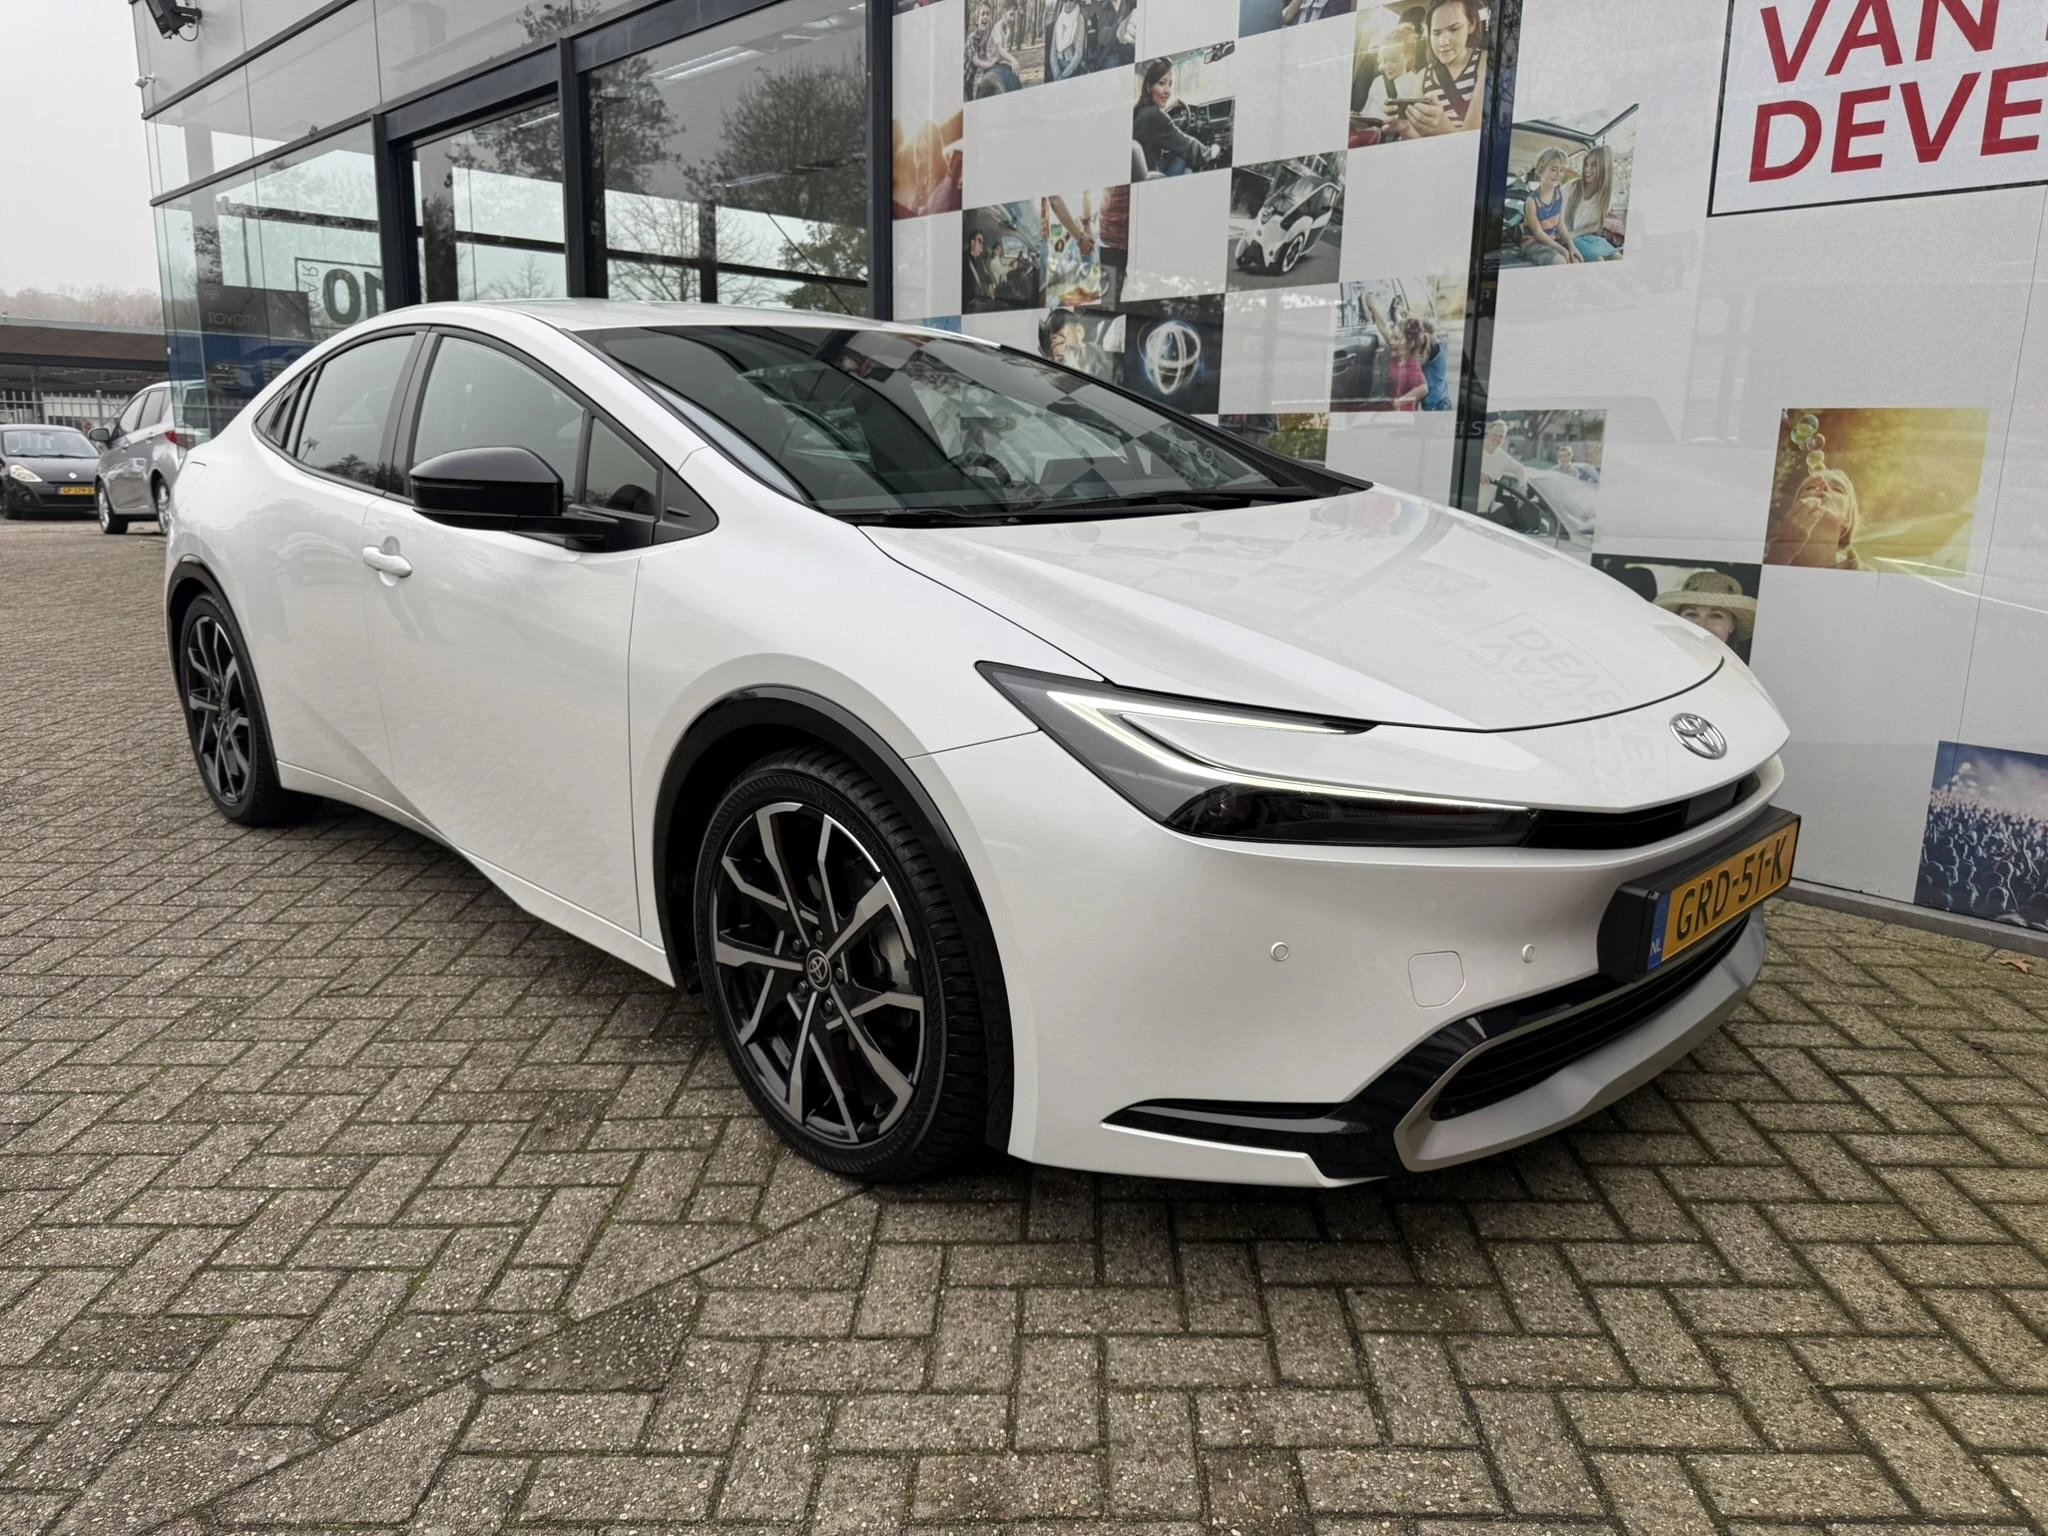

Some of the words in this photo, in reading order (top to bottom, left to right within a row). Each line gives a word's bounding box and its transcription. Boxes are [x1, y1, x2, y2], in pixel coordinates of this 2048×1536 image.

[1760, 0, 2000, 84] VAN
[1749, 62, 2048, 182] DEVE
[1677, 834, 1787, 941] GRD-51-K
[1651, 939, 1662, 956] NL
